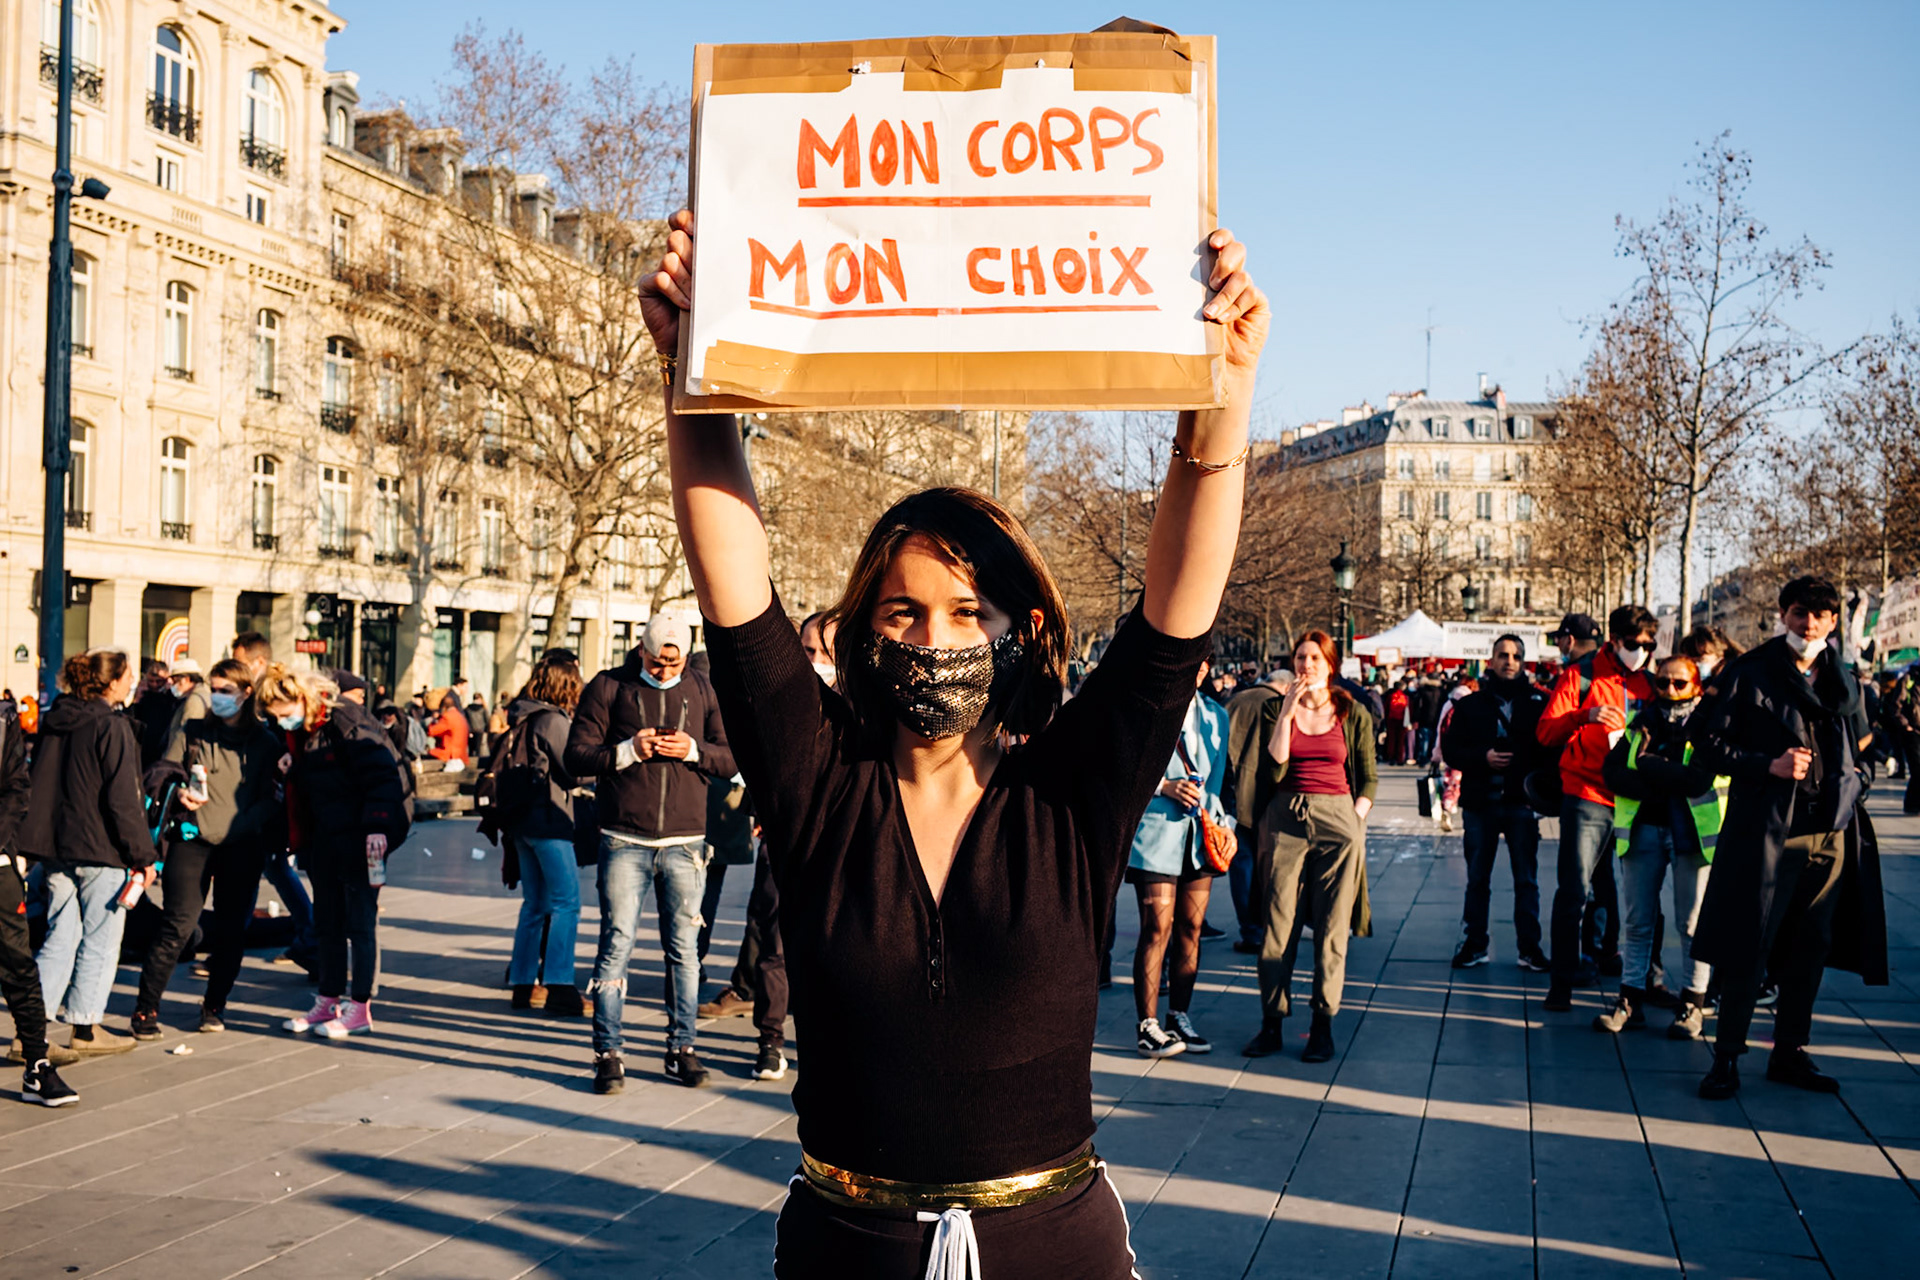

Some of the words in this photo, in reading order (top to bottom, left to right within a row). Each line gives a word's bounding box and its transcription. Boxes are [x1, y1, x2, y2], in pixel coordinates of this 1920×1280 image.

[797, 113, 940, 189] MON
[966, 106, 1164, 178] CORPS
[747, 238, 908, 306] MON
